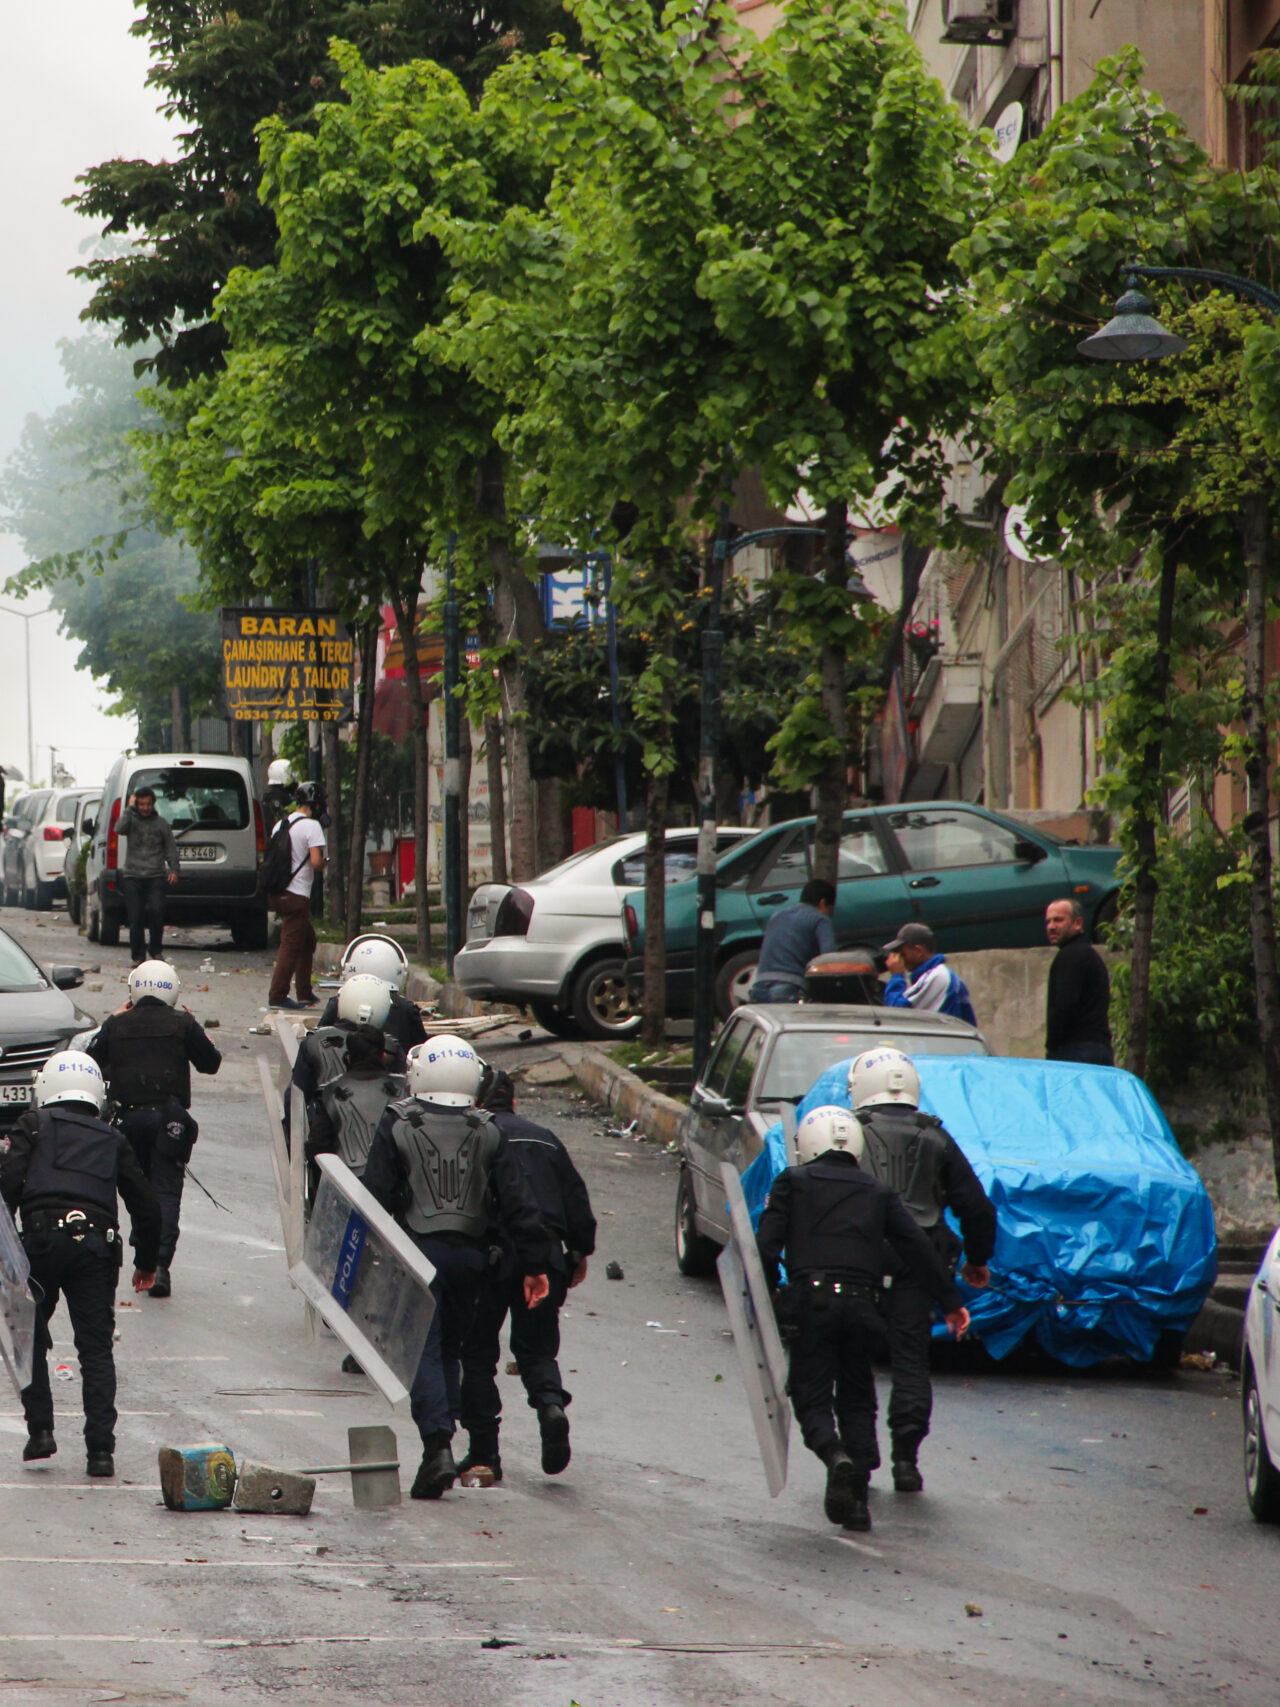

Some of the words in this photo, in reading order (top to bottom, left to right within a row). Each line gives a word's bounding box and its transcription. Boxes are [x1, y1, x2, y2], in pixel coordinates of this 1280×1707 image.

[241, 616, 337, 637] BARAN
[223, 639, 305, 667] ÇAMAŞIRHANE
[308, 640, 317, 661] &
[320, 637, 353, 663] TERZİ
[225, 666, 287, 689] LAUNDRY
[290, 666, 300, 689] &
[303, 667, 350, 689] TAILOR
[287, 690, 296, 708] &
[234, 709, 269, 720] 0534
[273, 709, 299, 720] 744
[302, 710, 319, 720] 50
[323, 710, 340, 720] 97
